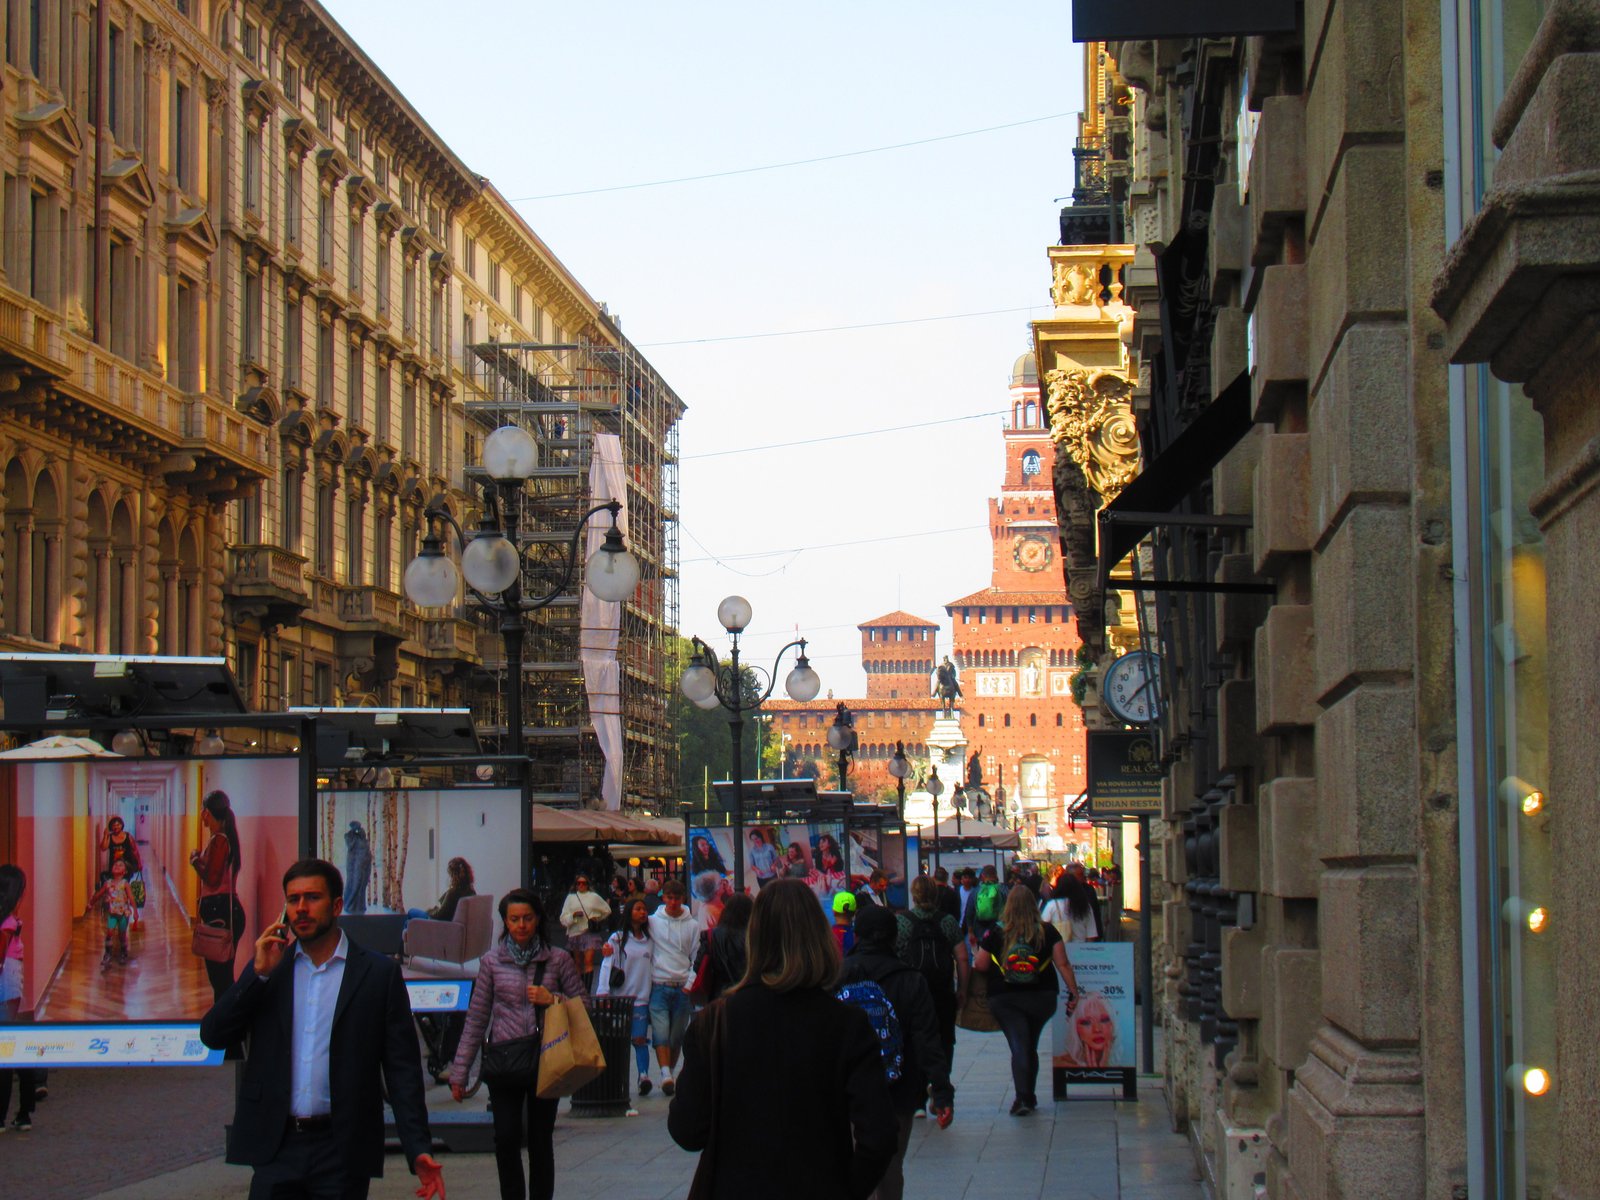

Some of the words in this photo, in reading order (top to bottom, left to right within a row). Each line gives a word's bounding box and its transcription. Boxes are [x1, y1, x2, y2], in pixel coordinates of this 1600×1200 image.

[1120, 673, 1129, 682] 10
[1116, 684, 1123, 692] 9
[1119, 694, 1126, 703] 8
[1138, 705, 1144, 714] 6
[1095, 800, 1128, 808] INDIAN
[1129, 800, 1161, 808] RESTA
[1100, 985, 1125, 995] -30%
[88, 1037, 111, 1055] 25
